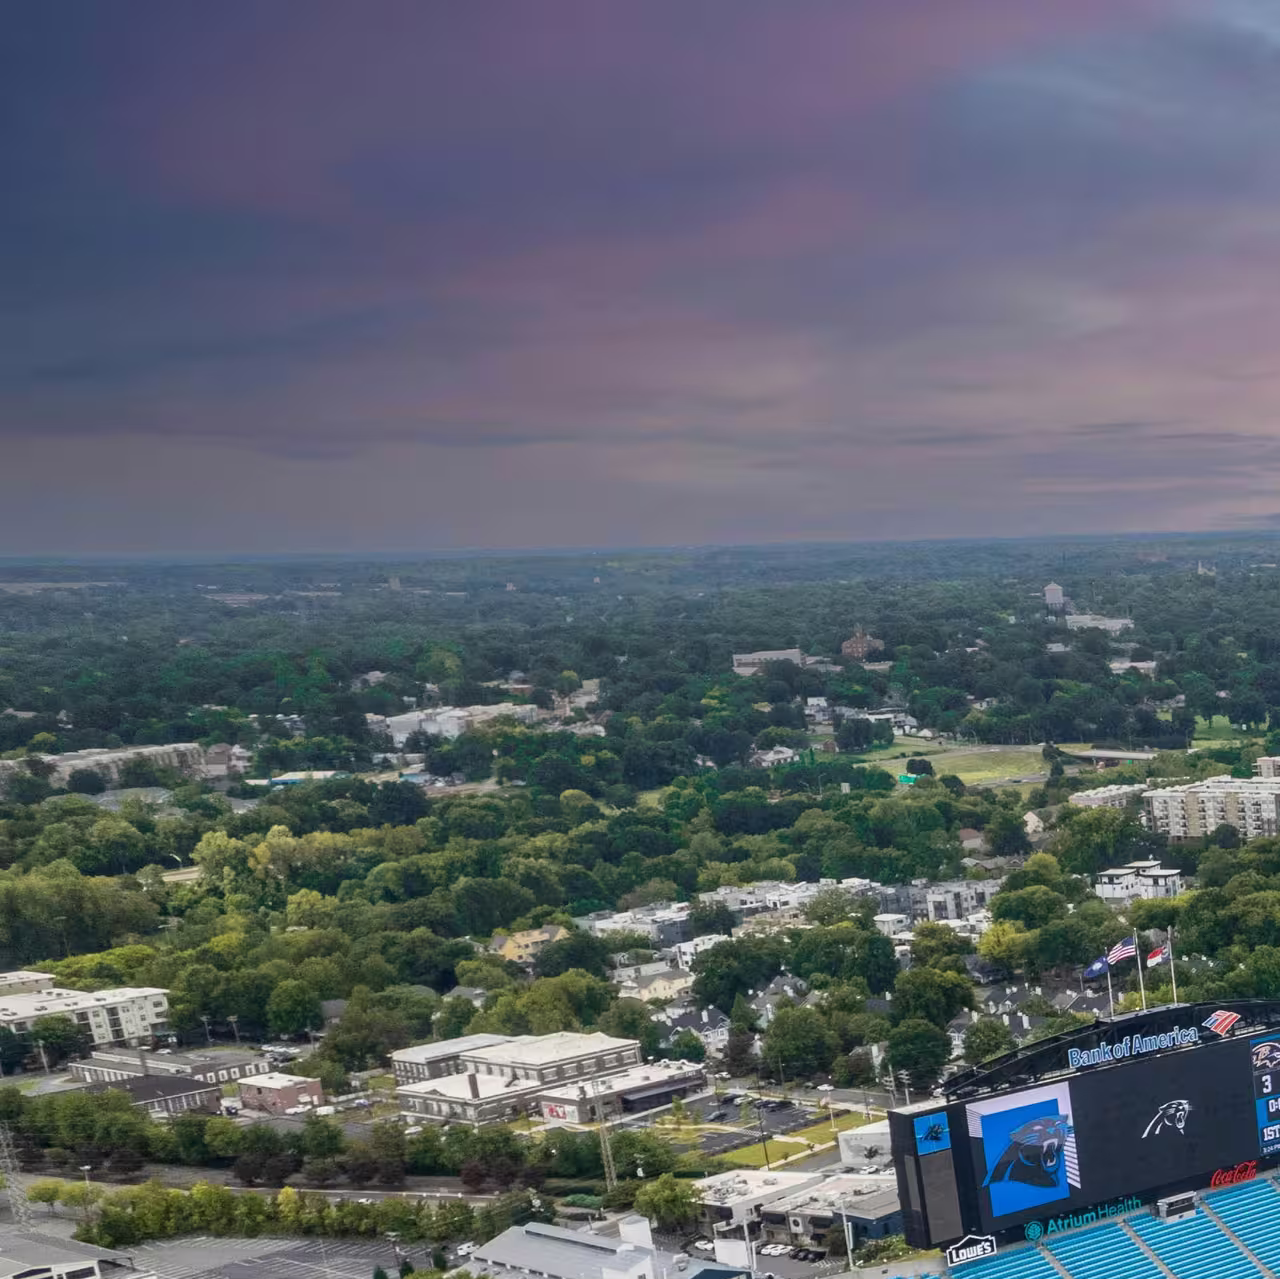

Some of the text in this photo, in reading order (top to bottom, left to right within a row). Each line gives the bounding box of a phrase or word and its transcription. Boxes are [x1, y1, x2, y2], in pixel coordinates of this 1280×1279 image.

[1068, 1026, 1199, 1068] Bank of America
[1262, 1075, 1272, 1093] 3
[1263, 1125, 1280, 1141] 1ST
[1211, 1160, 1257, 1190] Coca-Cola
[1048, 1196, 1142, 1235] Atrium Health
[952, 1241, 992, 1262] LOWE'S
